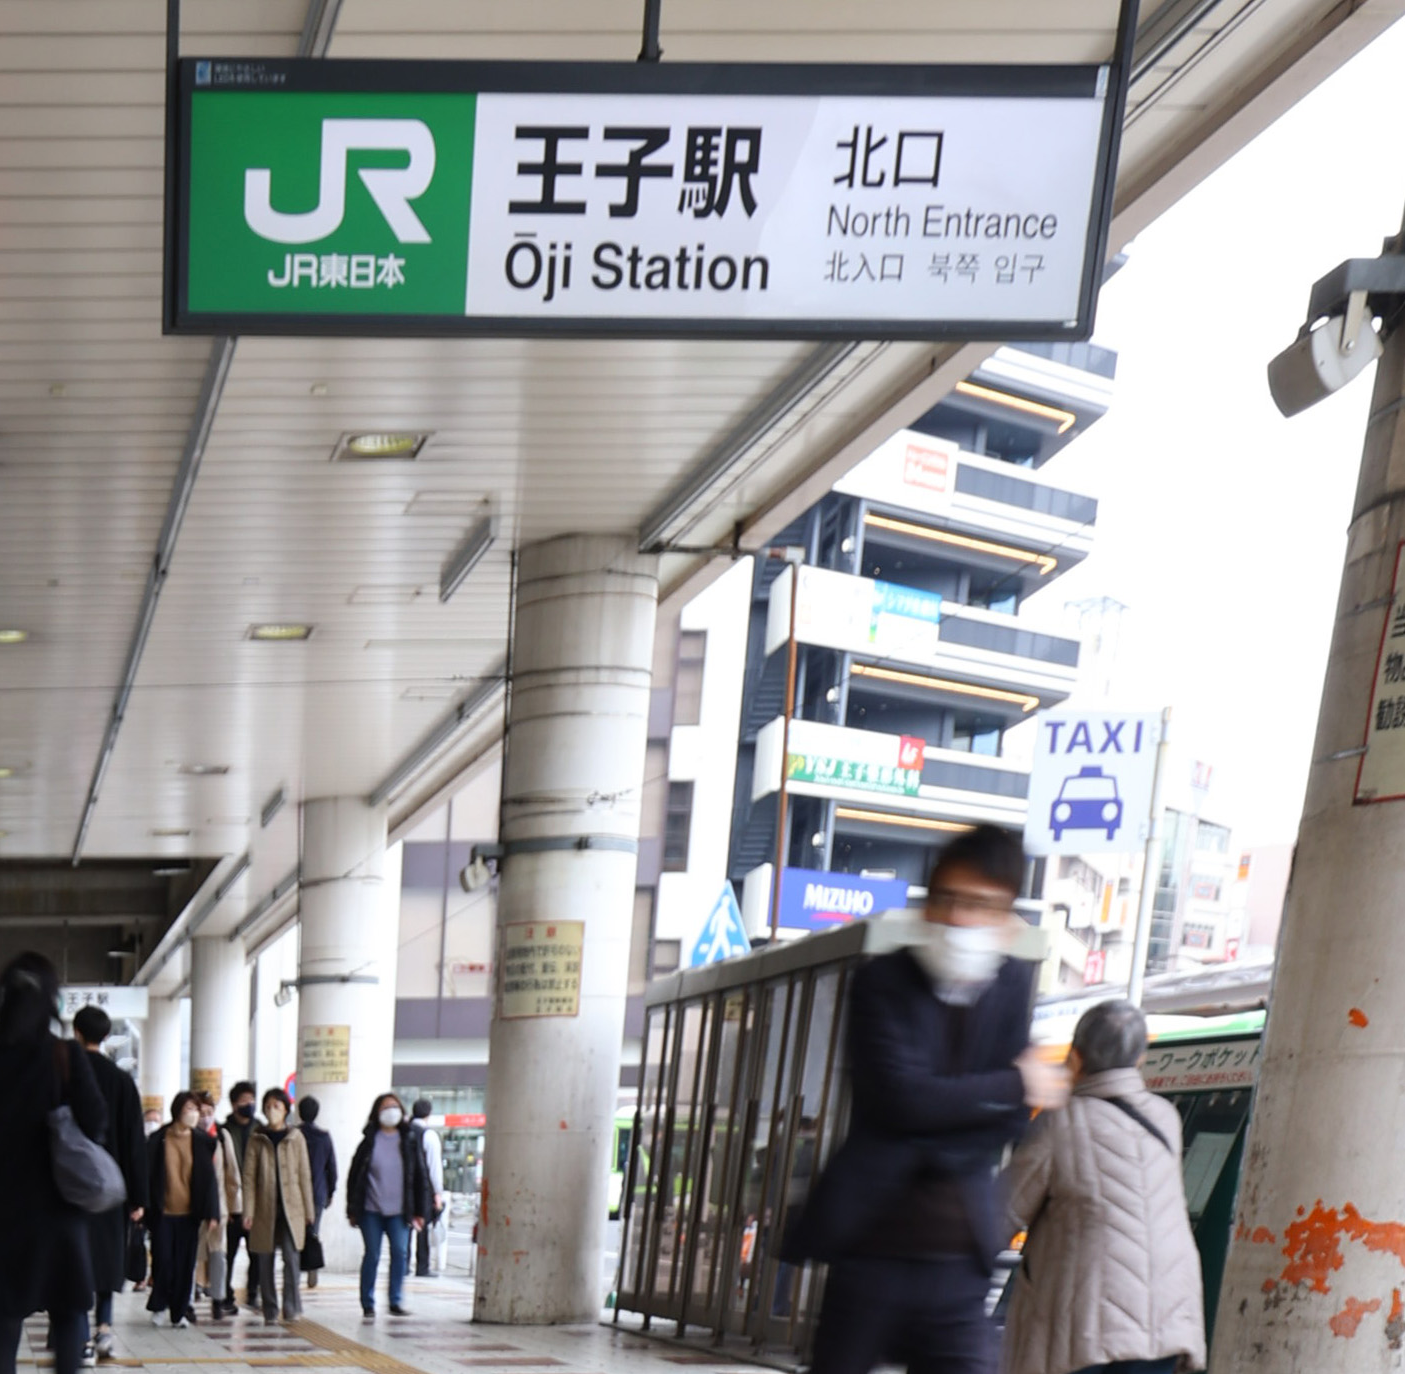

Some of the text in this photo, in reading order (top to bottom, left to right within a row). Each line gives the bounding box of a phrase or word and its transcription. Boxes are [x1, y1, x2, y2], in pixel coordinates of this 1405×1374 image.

[508, 125, 762, 218] 王子駅
[833, 125, 944, 188] 北口
[244, 118, 436, 244] JR
[826, 203, 1057, 239] North Entrance
[267, 252, 406, 289] JR東日本
[504, 232, 769, 302] Ōji Station
[823, 251, 904, 283] 北入口
[928, 252, 1045, 285] 북쪽 입구
[1384, 653, 1405, 685] 物
[1044, 720, 1143, 754] TAXI
[803, 883, 874, 915] MIZUHO
[67, 992, 110, 1006] 王子駅
